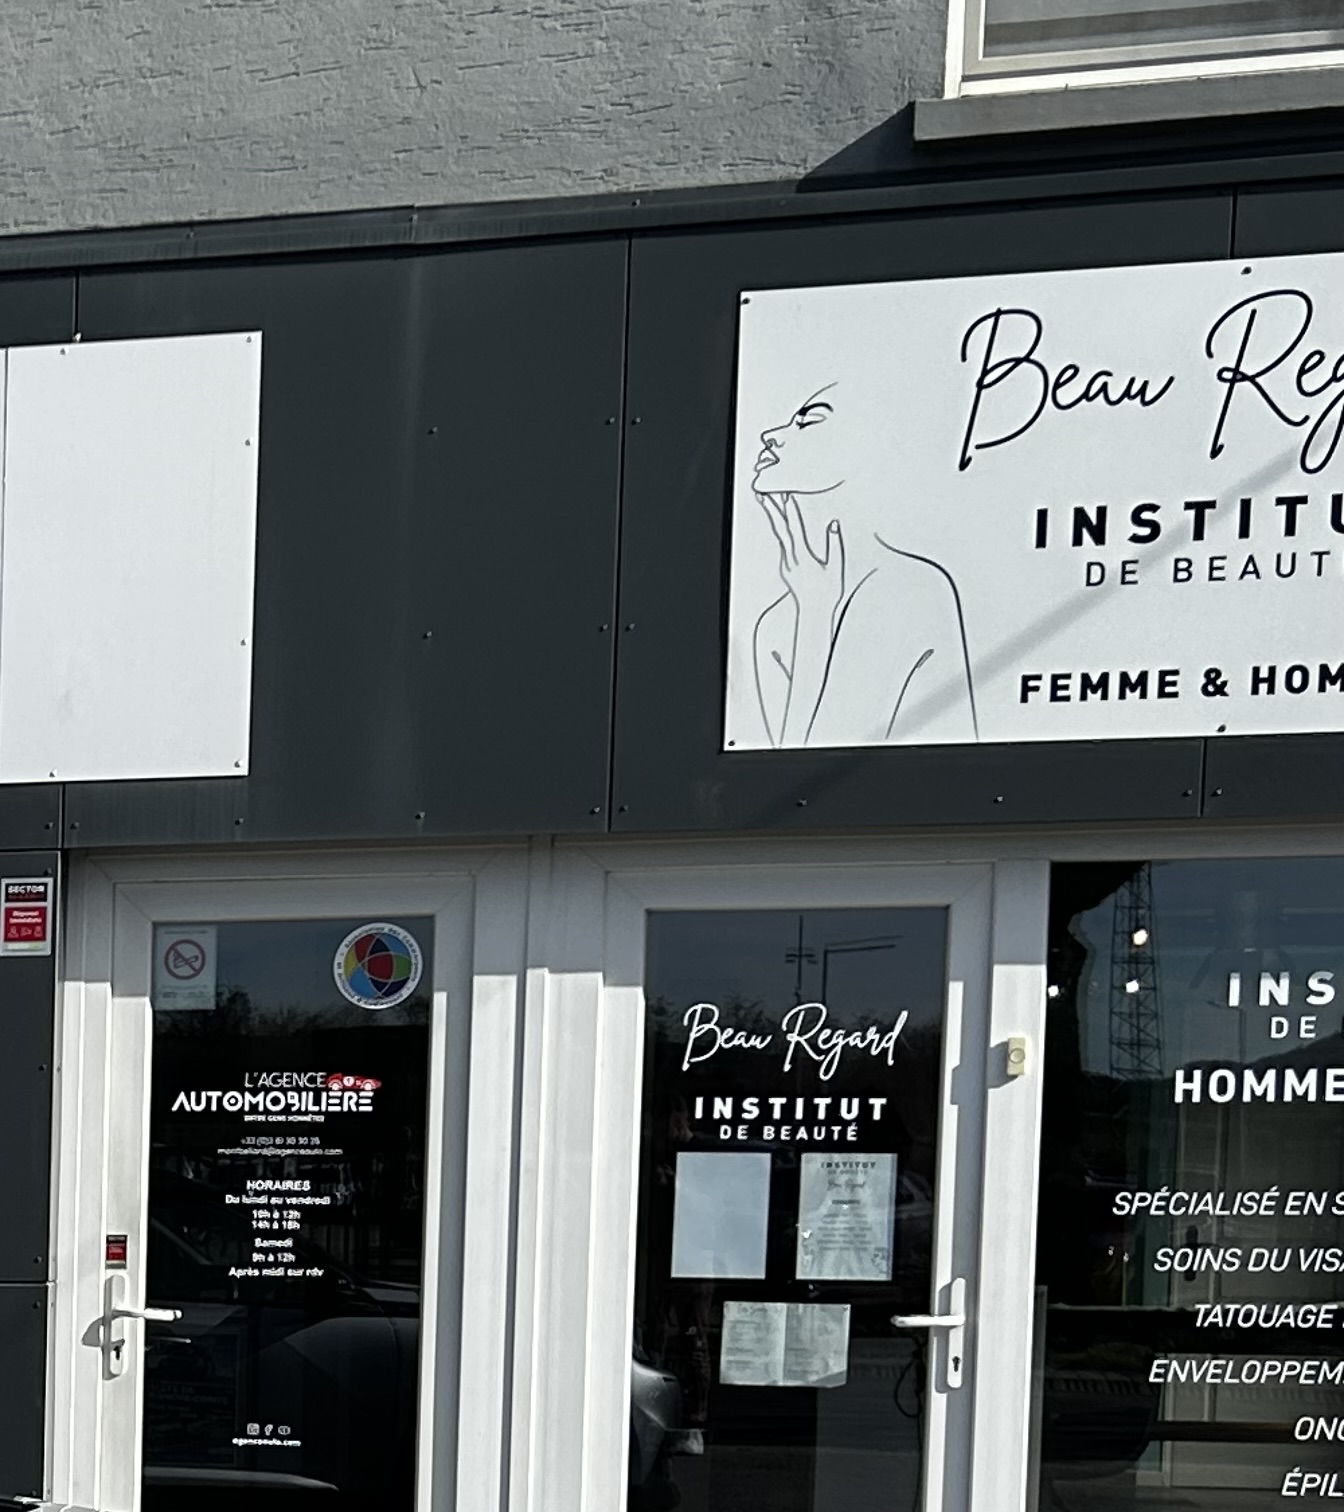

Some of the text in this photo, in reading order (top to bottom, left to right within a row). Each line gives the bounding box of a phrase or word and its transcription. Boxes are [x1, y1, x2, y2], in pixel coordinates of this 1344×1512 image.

[959, 307, 1175, 471] Beau
[1085, 550, 1331, 587] DE BEAUT
[1019, 668, 1181, 703] FEMME
[1200, 666, 1230, 698] &
[1227, 970, 1336, 1007] INS
[1270, 1016, 1318, 1039] DE
[681, 1002, 909, 1081] Beau Regard
[244, 1072, 327, 1088] L'AGENCE
[694, 1096, 888, 1120] INSTITUT
[719, 1122, 859, 1142] DE BEAUTÉ
[246, 1180, 311, 1191] HORAIRES
[225, 1194, 240, 1204] Du
[1111, 1186, 1281, 1217] SPÉCIALISÉ
[1283, 1190, 1327, 1216] EN
[1152, 1247, 1243, 1272] SOINS
[1247, 1247, 1290, 1272] DU
[1194, 1303, 1338, 1328] TATOUAGE
